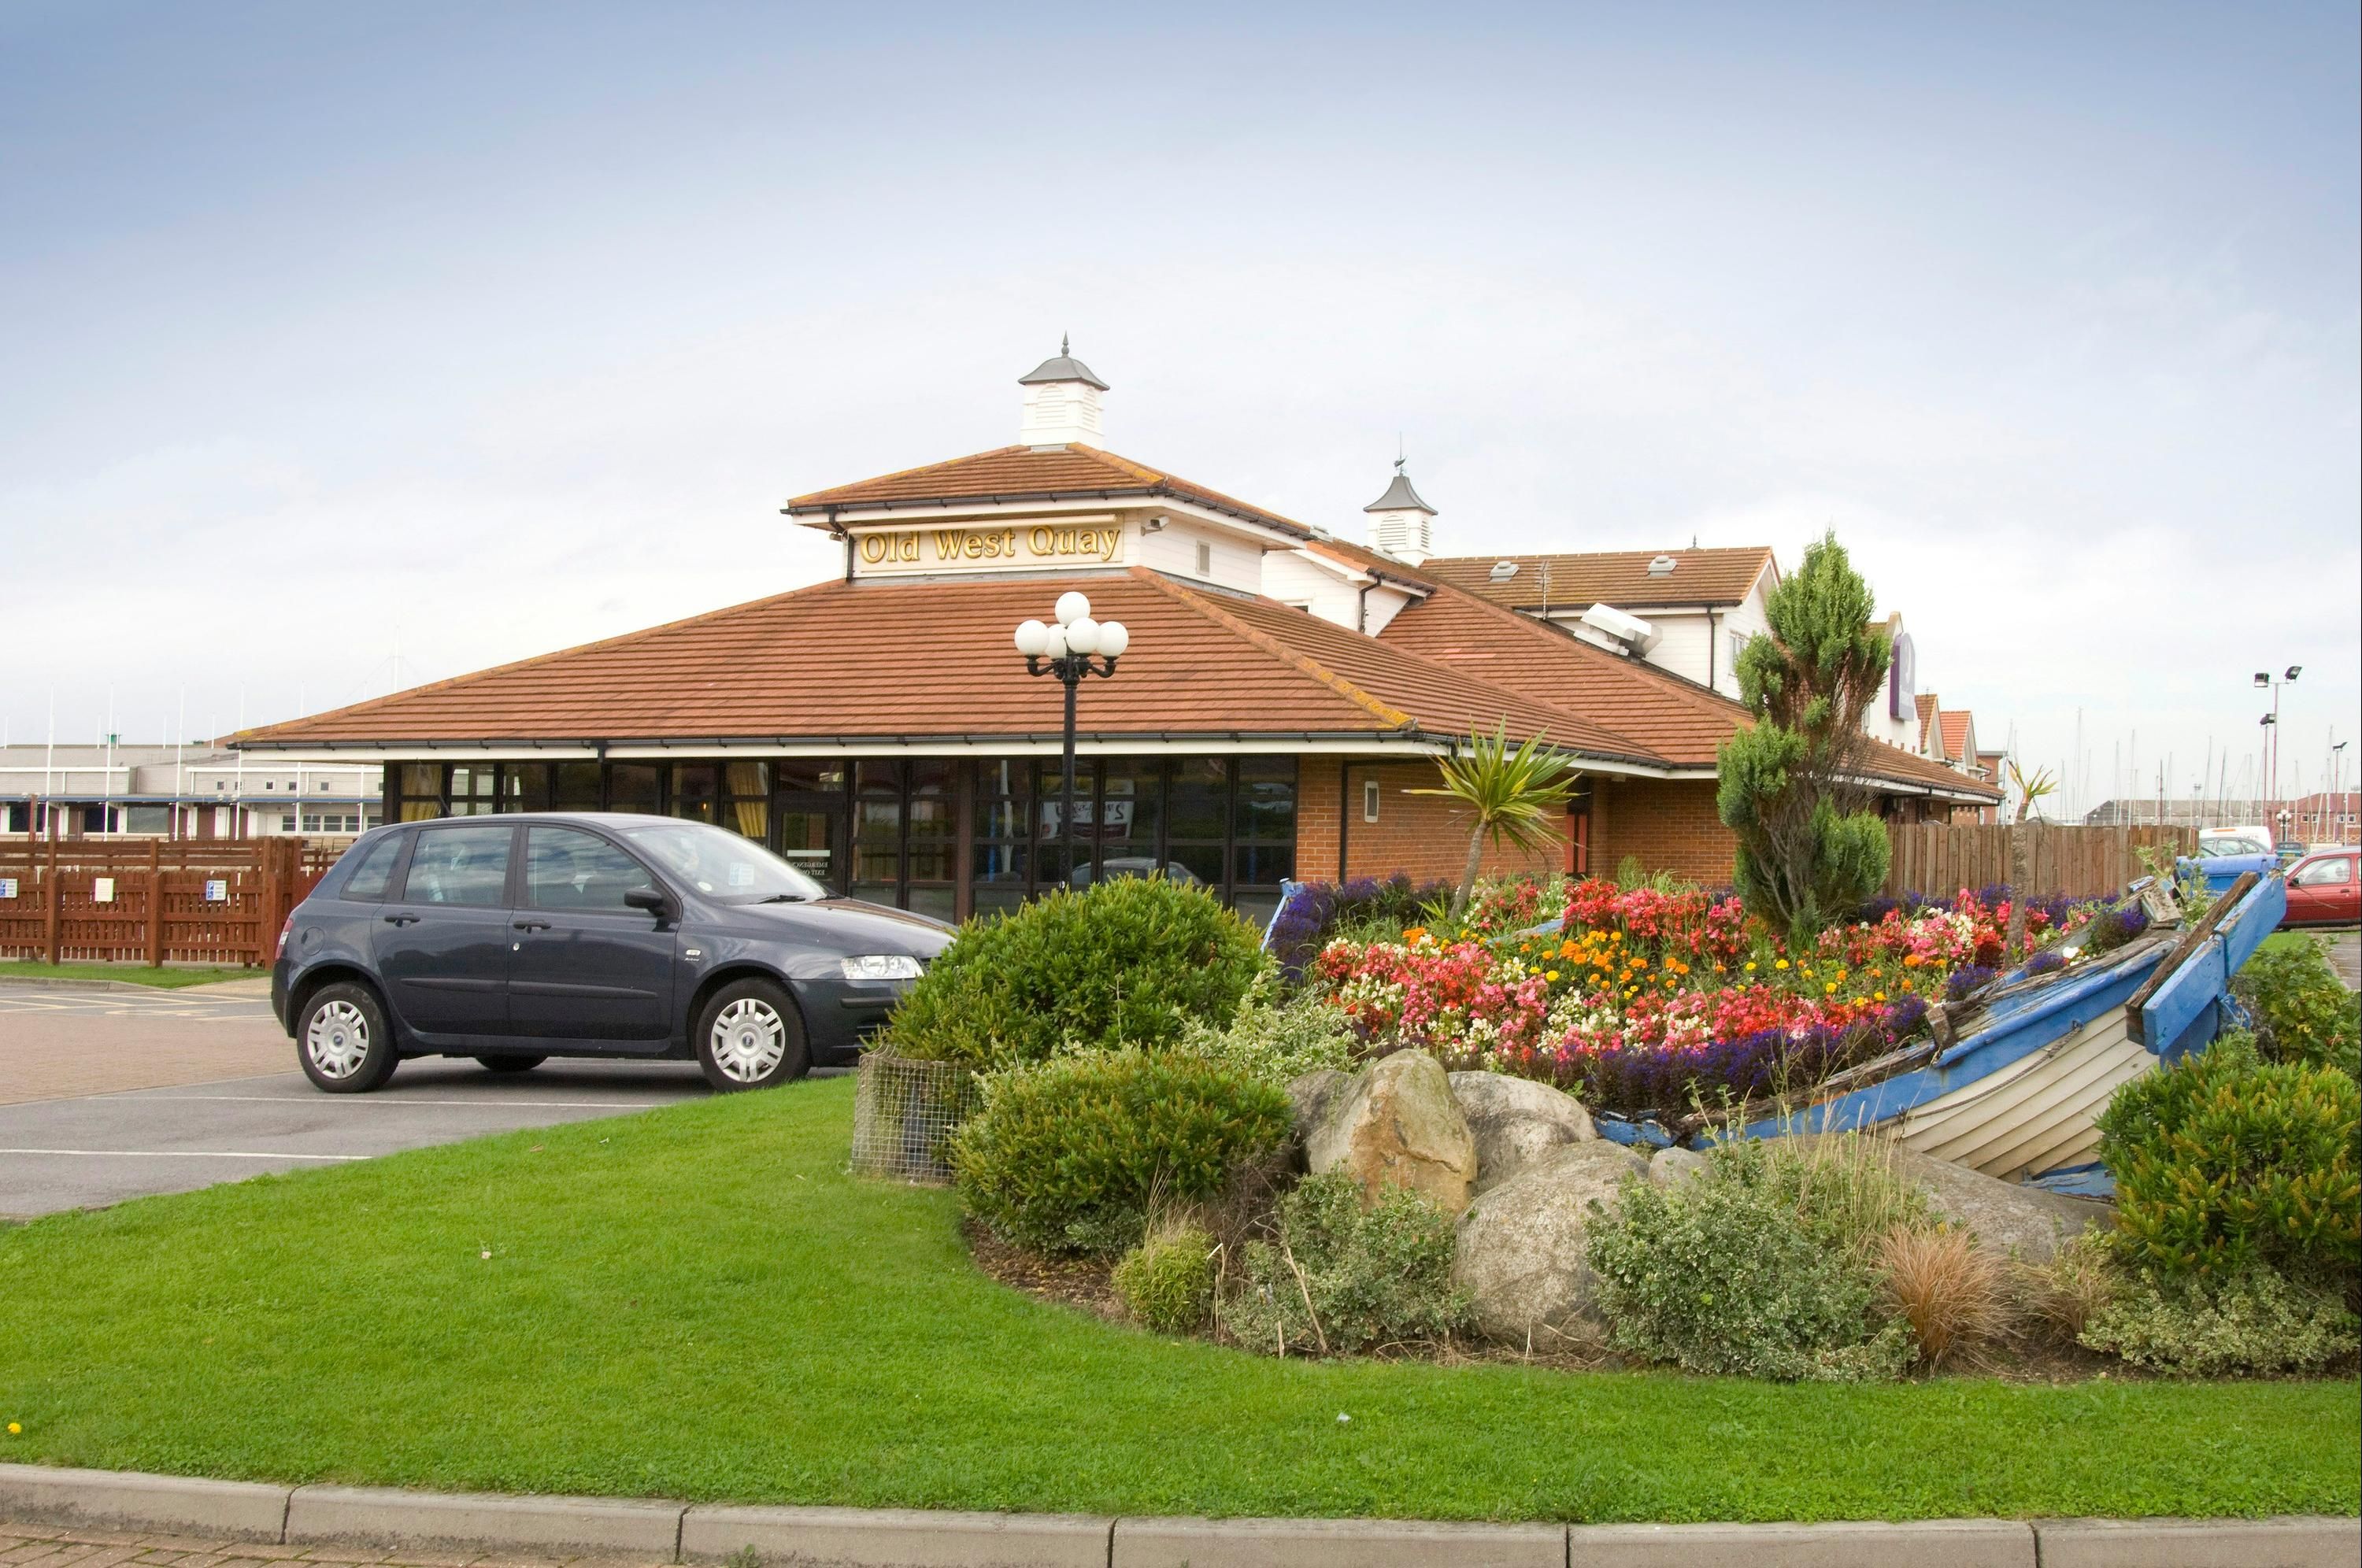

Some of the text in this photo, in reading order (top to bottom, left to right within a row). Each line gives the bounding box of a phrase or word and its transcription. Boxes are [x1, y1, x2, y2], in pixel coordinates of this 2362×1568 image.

[861, 524, 1120, 563] Old West Quay
